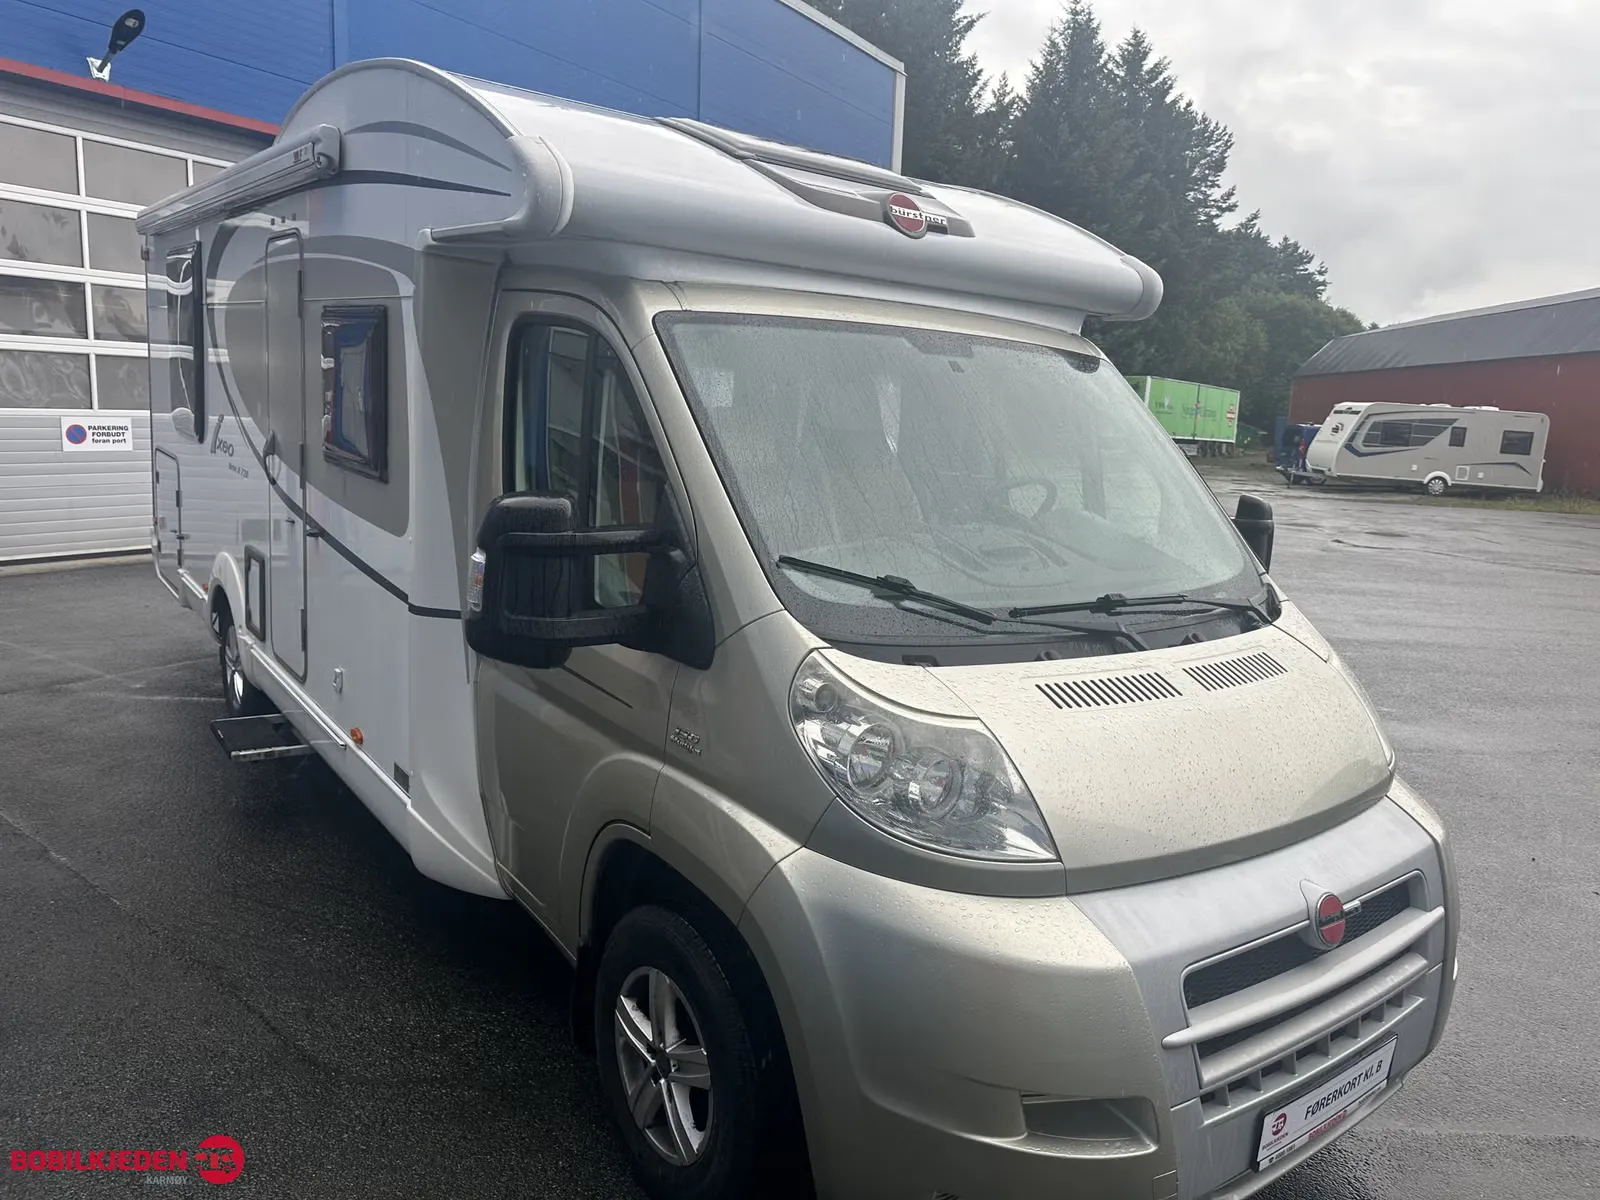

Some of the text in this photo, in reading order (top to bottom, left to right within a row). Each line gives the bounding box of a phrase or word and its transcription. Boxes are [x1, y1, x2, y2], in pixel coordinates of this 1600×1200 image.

[889, 205, 947, 225] bürstner
[1304, 1073, 1363, 1120] FØRERKORT
[1375, 1060, 1384, 1073] B
